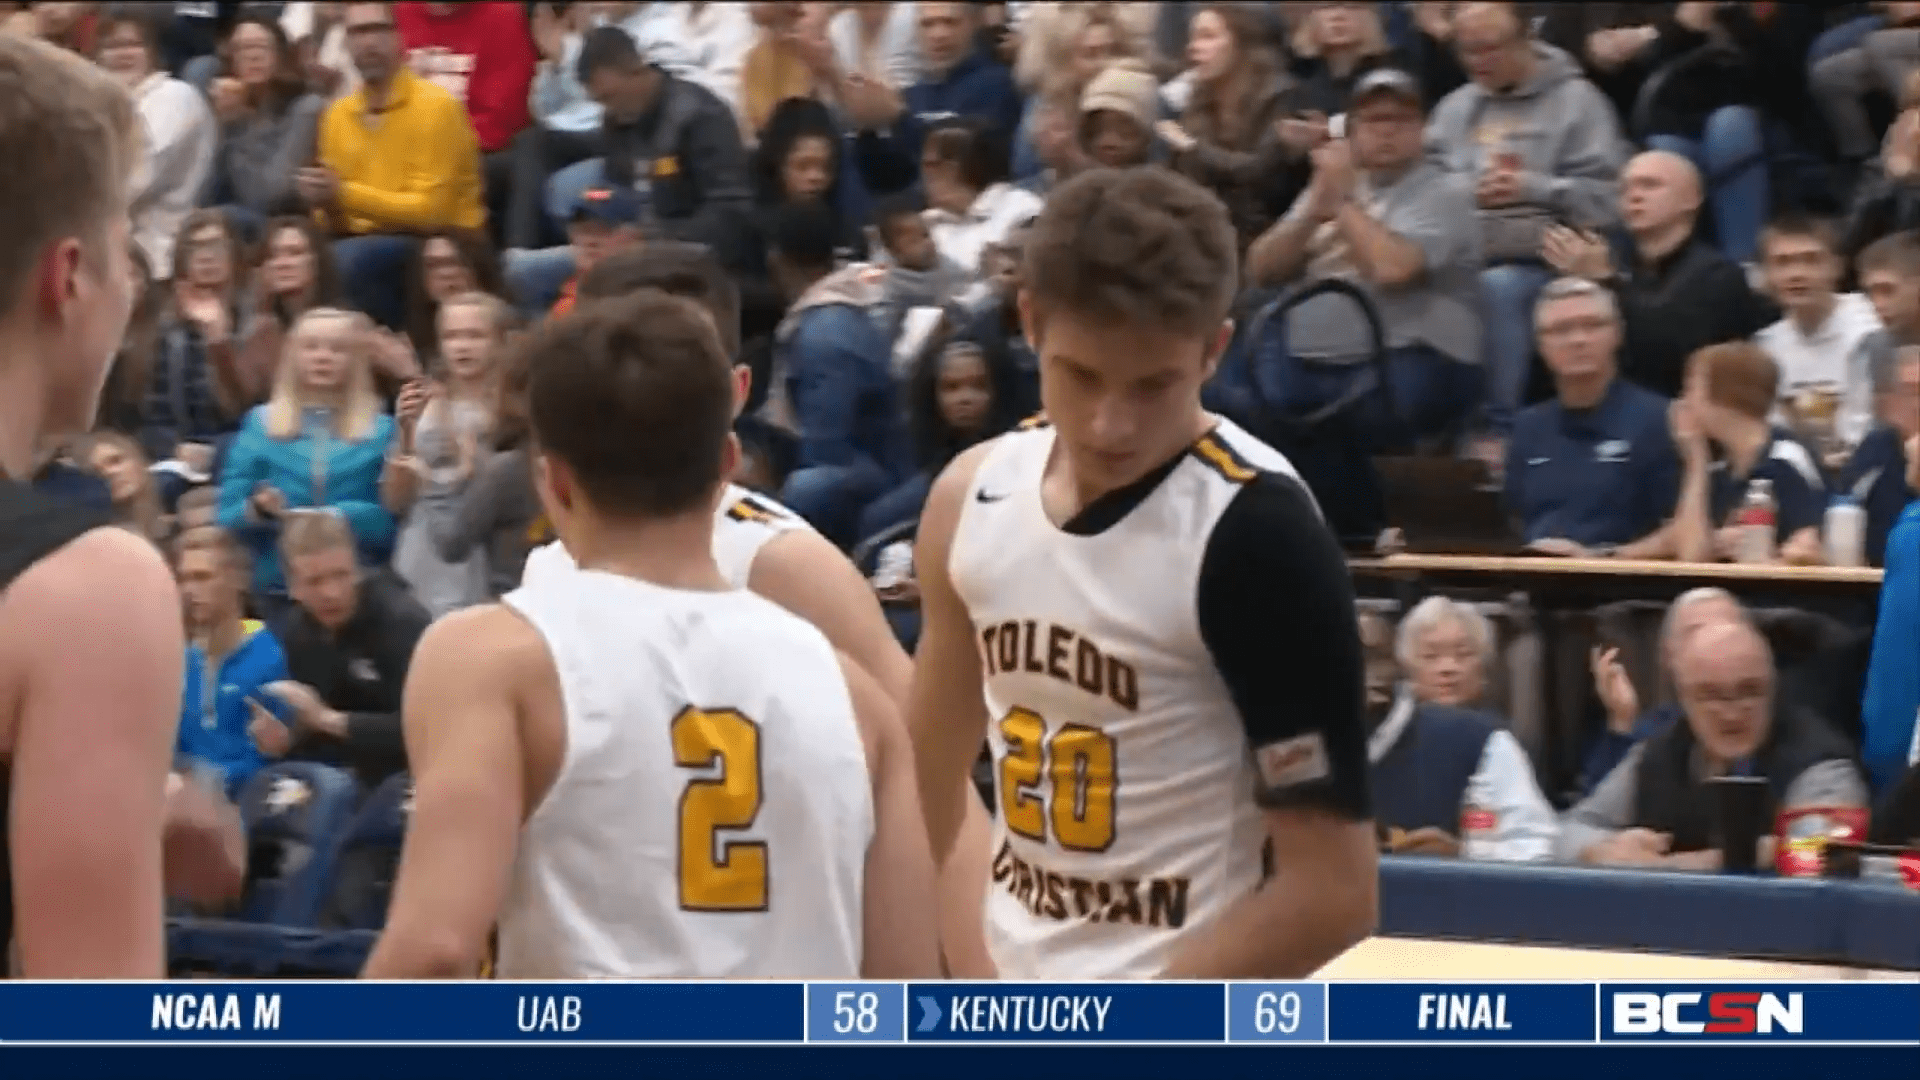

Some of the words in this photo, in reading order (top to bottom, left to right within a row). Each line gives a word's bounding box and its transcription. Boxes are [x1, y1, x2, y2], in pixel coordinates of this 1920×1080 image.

[982, 619, 1139, 712] TOLEDO
[671, 705, 769, 912] 2
[1001, 705, 1118, 853] 20
